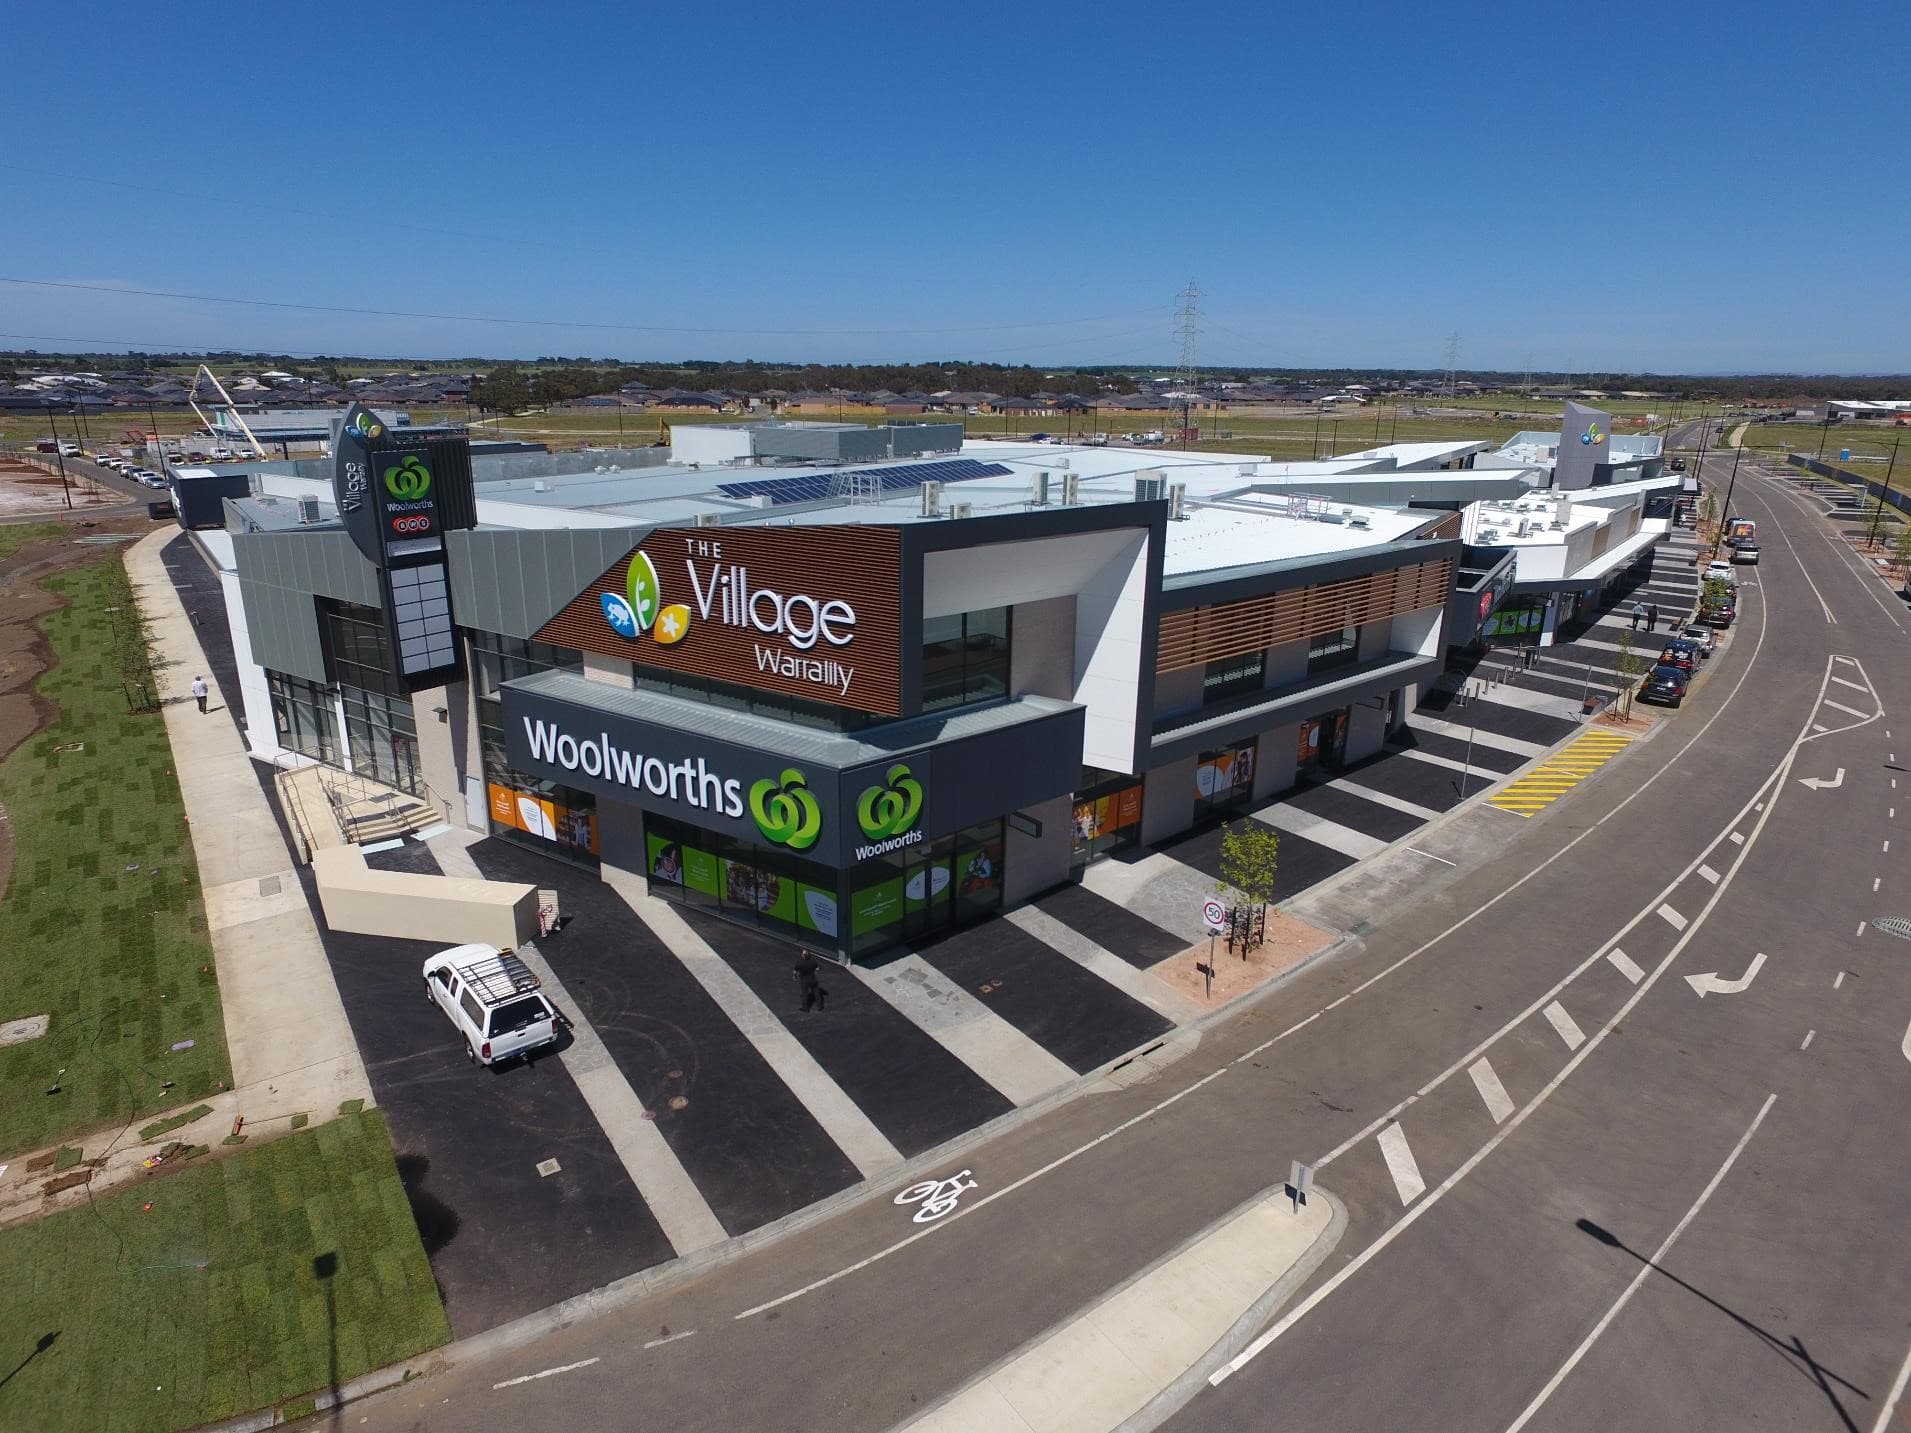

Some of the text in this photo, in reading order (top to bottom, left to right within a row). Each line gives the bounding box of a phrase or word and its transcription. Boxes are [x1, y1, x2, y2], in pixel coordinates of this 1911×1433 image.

[345, 462, 361, 510] Village
[386, 500, 433, 512] Woolworths
[686, 538, 722, 559] THE
[686, 559, 857, 649] Village
[754, 643, 854, 696] Warralily
[522, 716, 744, 818] Woolworths
[855, 829, 923, 861] Woolworths
[1208, 906, 1221, 920] 50
